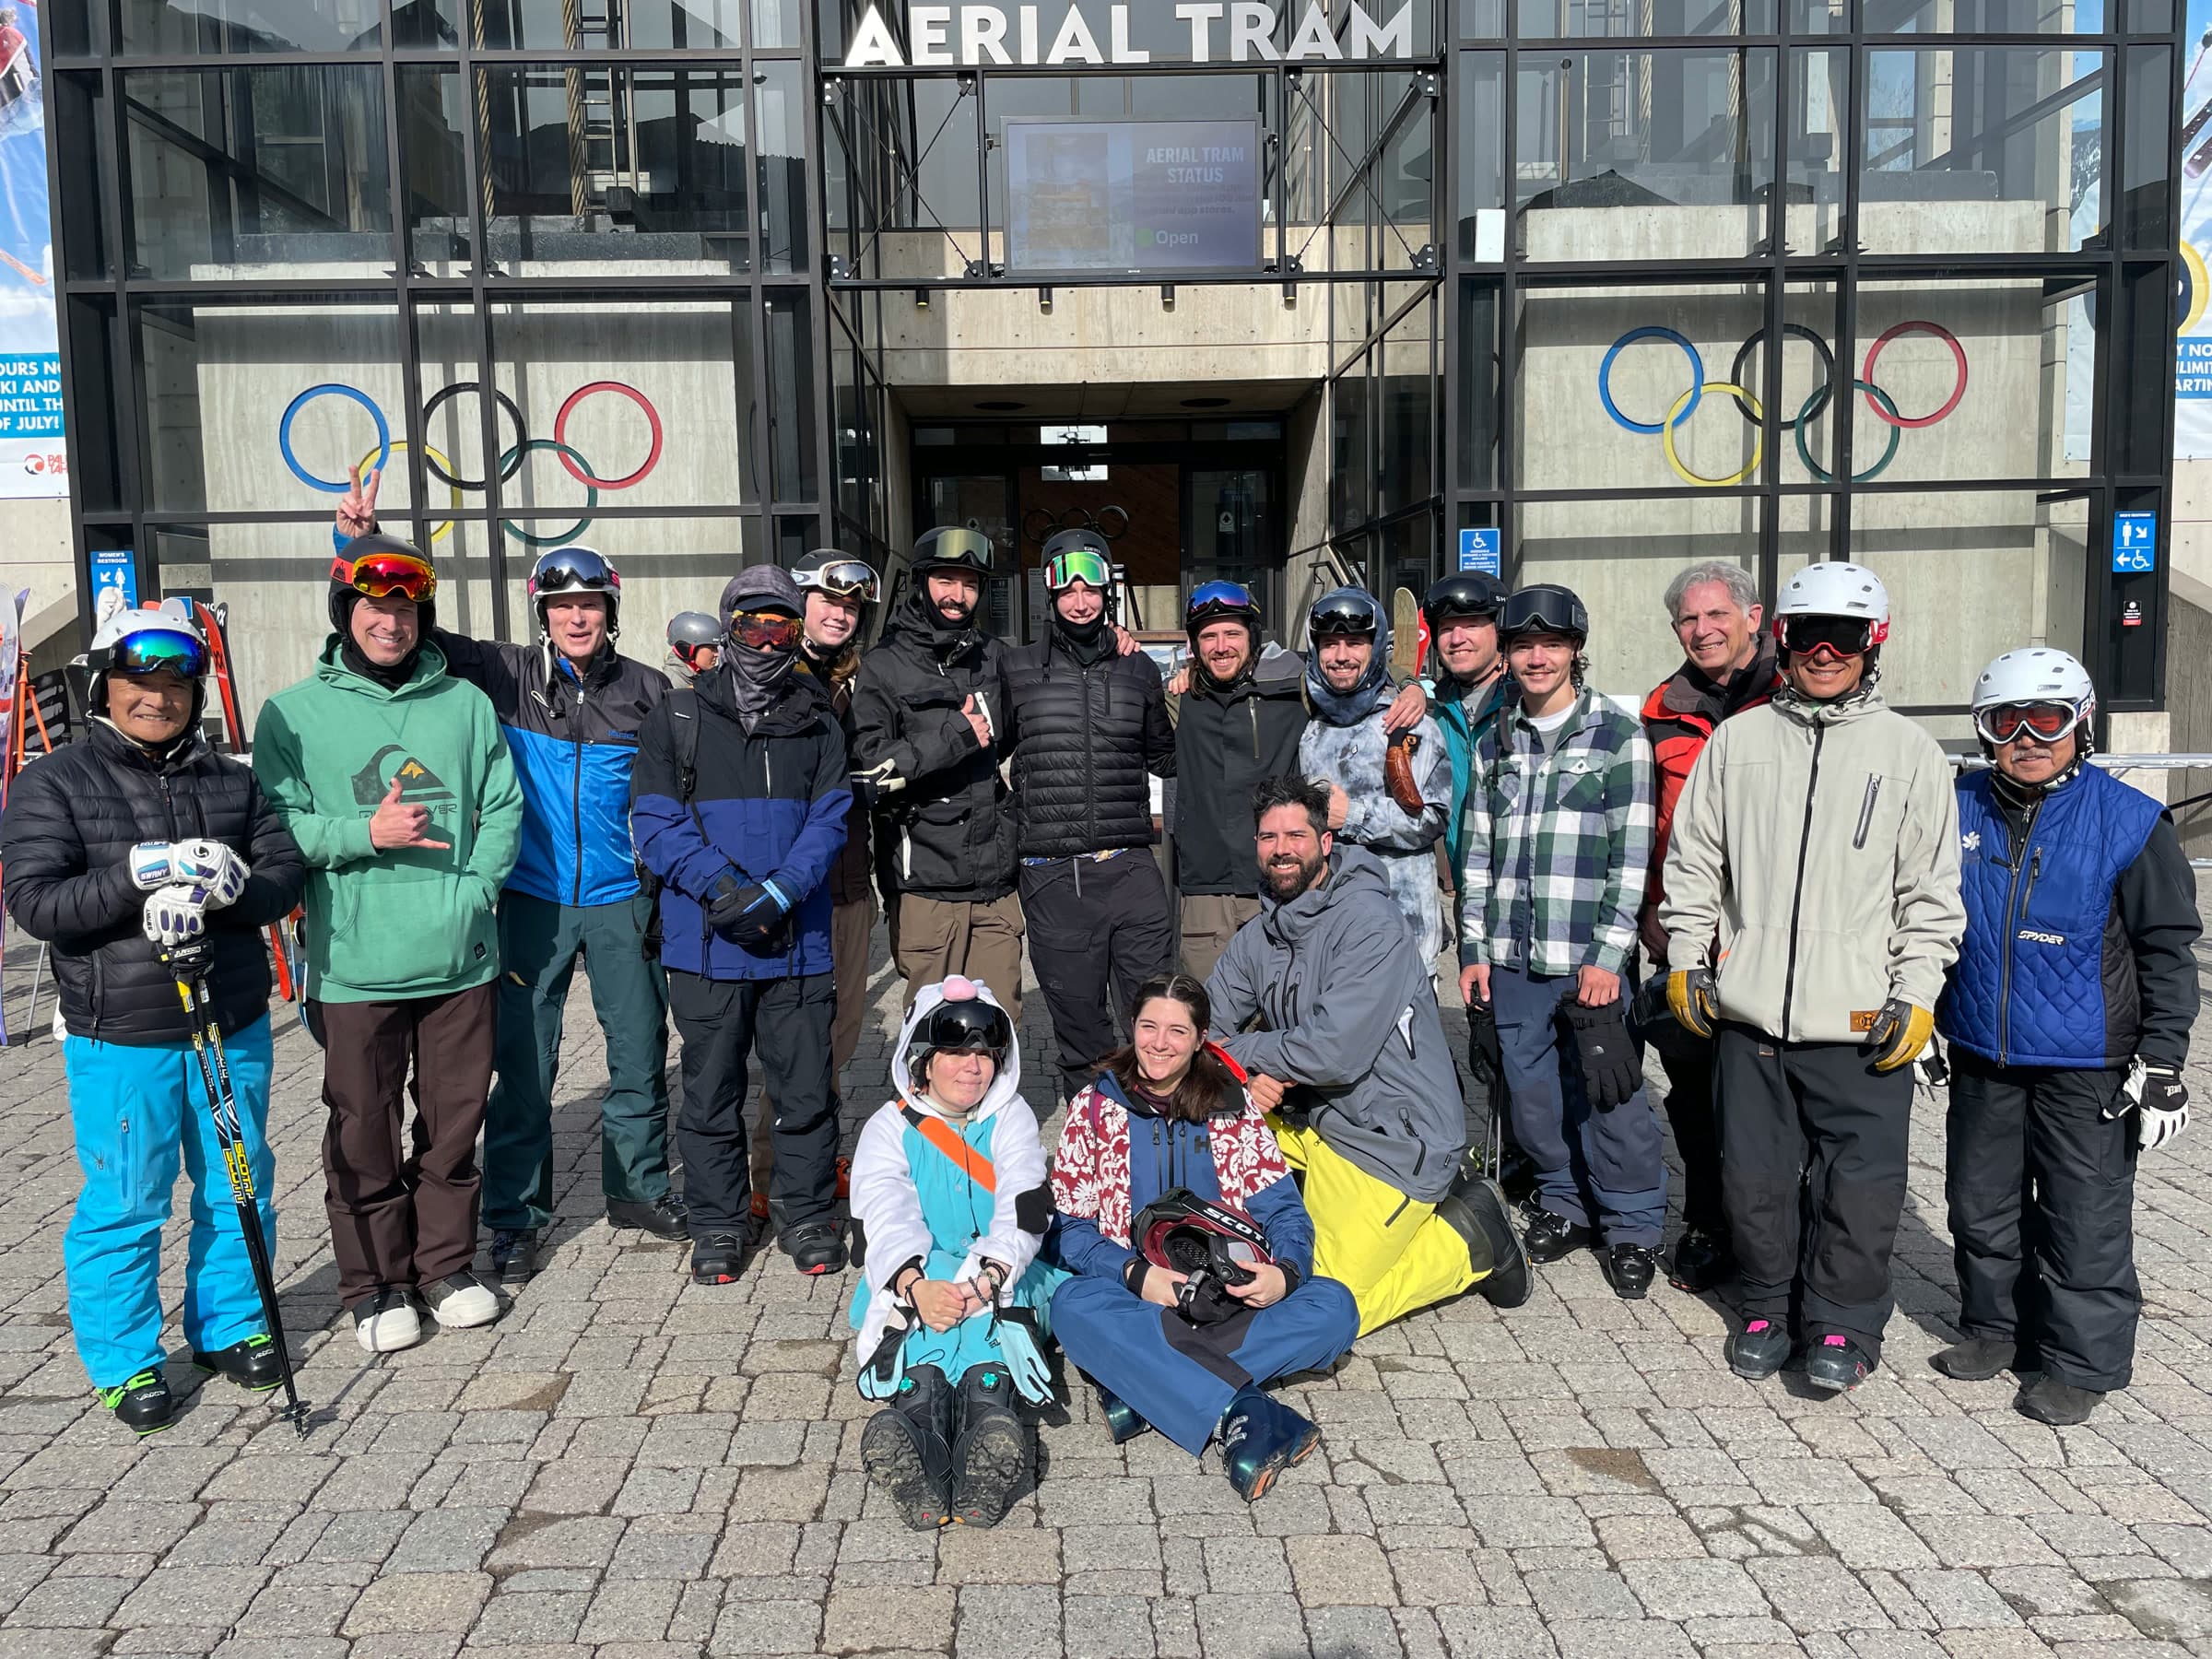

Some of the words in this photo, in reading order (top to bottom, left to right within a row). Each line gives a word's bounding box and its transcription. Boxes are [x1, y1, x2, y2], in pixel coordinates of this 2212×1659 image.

[844, 3, 1150, 66] AERIAL
[1175, 0, 1412, 62] TRAM
[1147, 147, 1198, 163] AERIAL
[1202, 147, 1244, 162] TRAM
[1168, 168, 1223, 183] STATUS
[1156, 230, 1198, 247] Open
[43, 361, 61, 375] N
[22, 379, 60, 394] AND
[0, 397, 40, 413] NTIL
[17, 416, 59, 430] JULY!
[141, 869, 168, 880] SWANY
[2018, 930, 2065, 946] SPYDER
[234, 1142, 255, 1198] SCOTT
